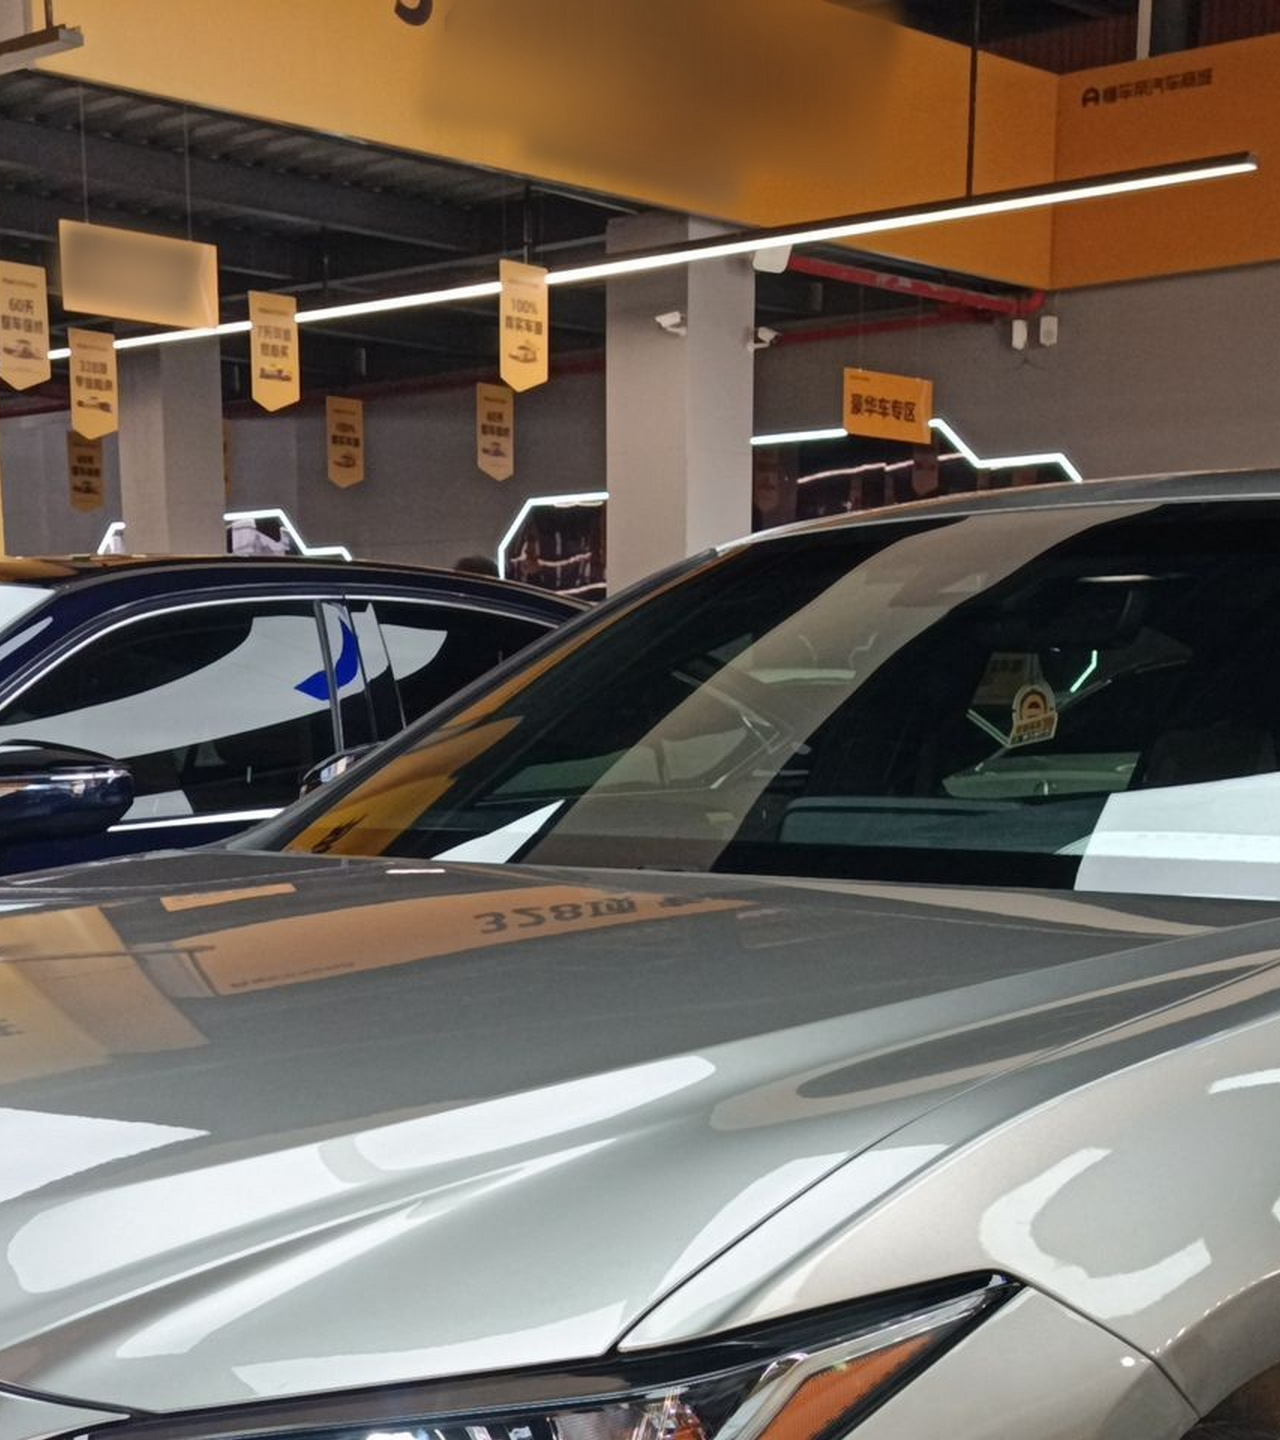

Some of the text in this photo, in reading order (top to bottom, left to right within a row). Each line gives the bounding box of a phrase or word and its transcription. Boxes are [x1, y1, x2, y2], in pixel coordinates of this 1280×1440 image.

[851, 394, 917, 422] 豪华车专区
